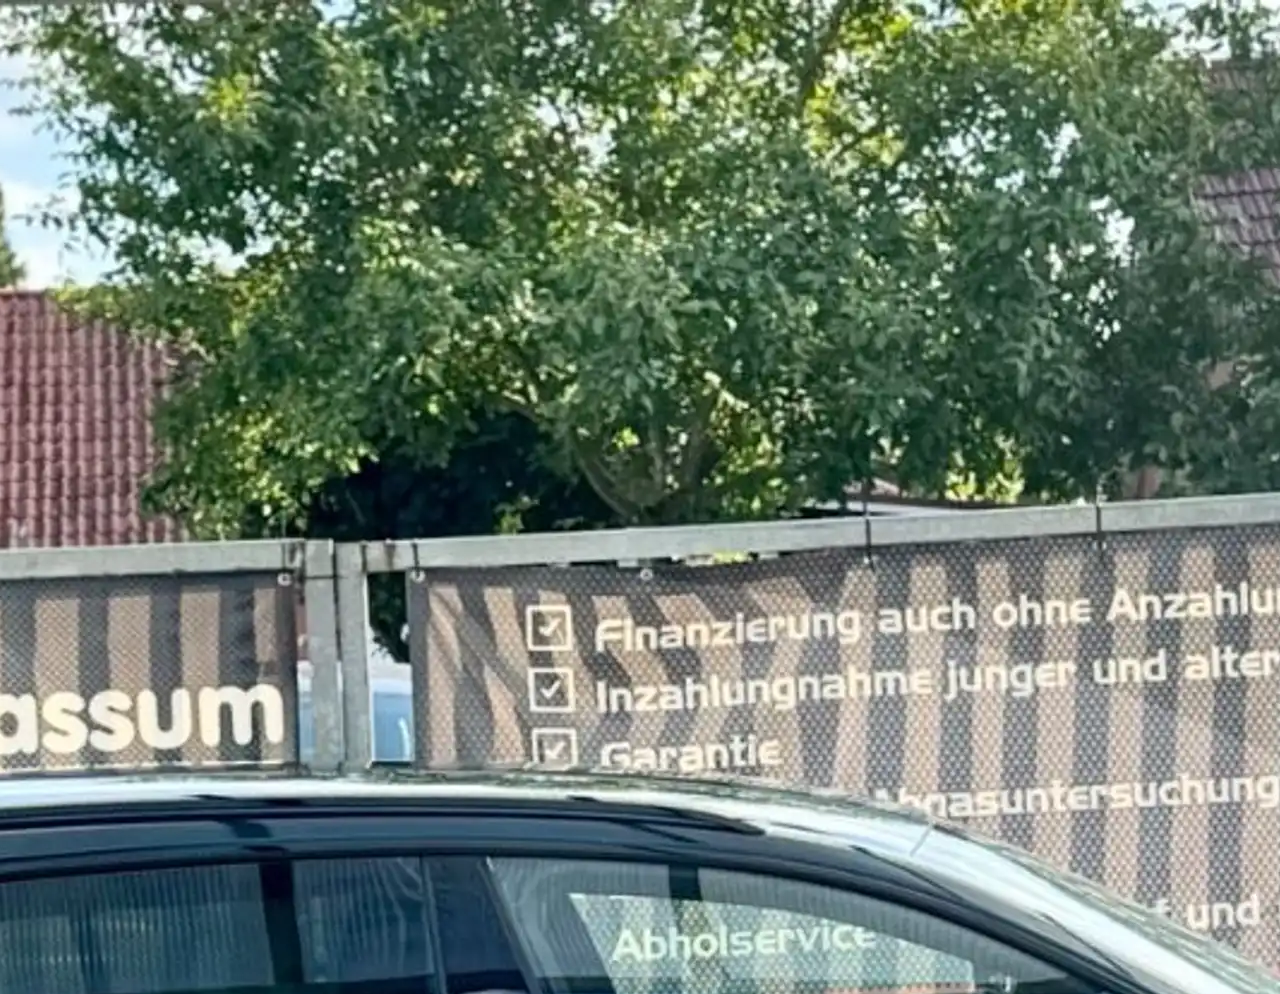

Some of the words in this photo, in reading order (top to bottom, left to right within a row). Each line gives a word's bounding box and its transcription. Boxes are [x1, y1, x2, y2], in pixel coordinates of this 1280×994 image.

[596, 605, 859, 653] Finanzierung
[878, 597, 975, 633] auch
[992, 595, 1091, 627] ohne
[598, 666, 932, 714] Inzahlungnahme
[945, 658, 1076, 700] junger
[1094, 645, 1167, 684] und
[1185, 638, 1279, 680] alter
[600, 735, 782, 773] Garantie
[612, 922, 876, 962] Abholservice
[1186, 893, 1260, 931] und
